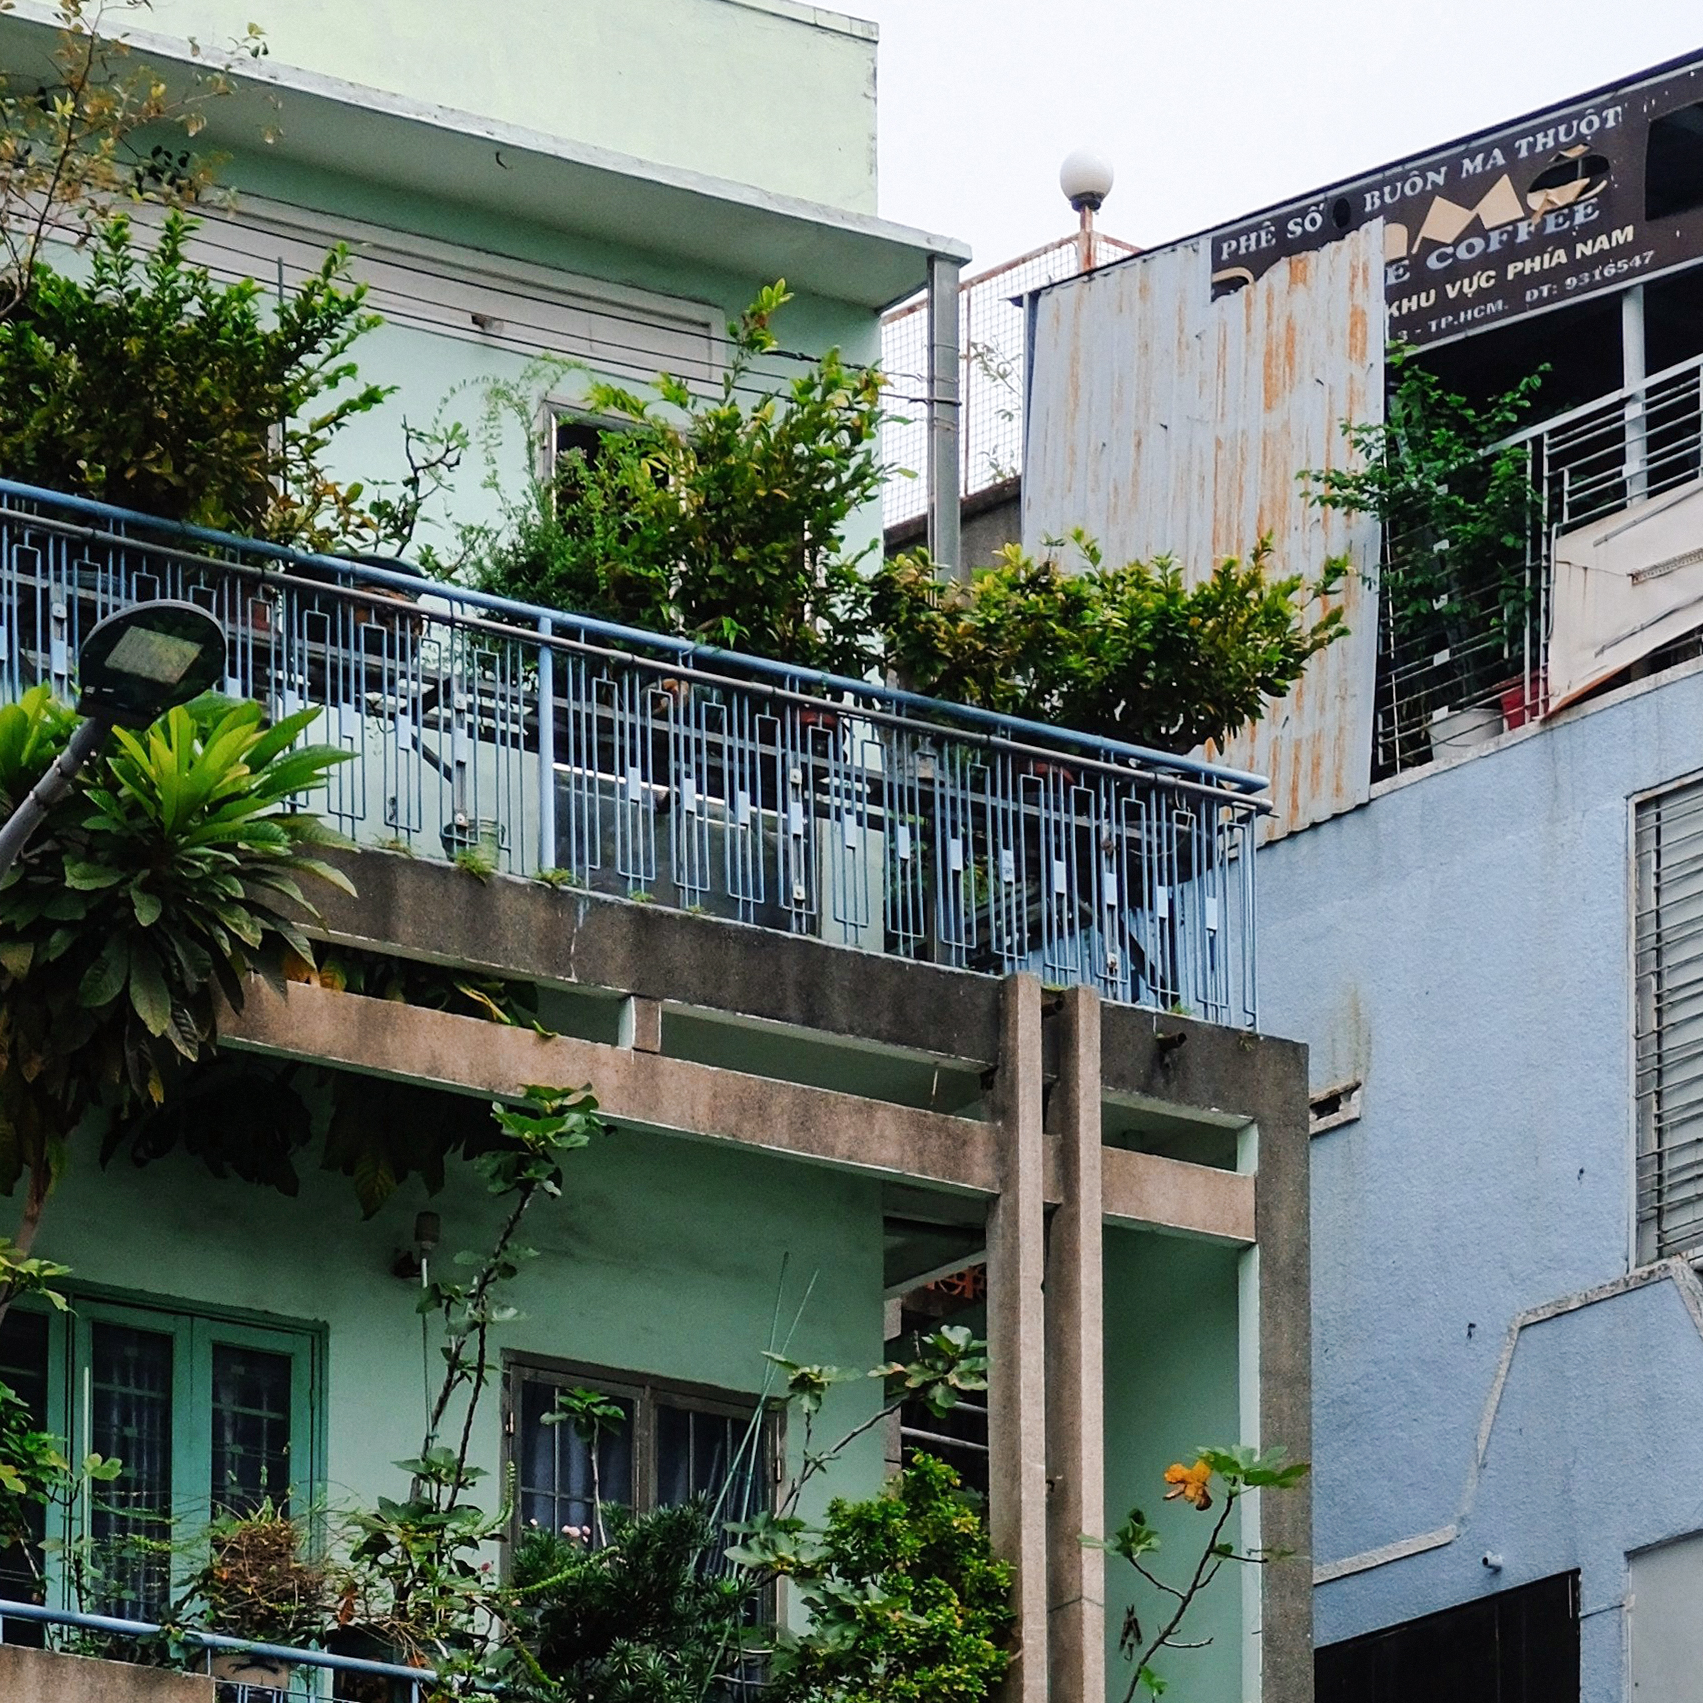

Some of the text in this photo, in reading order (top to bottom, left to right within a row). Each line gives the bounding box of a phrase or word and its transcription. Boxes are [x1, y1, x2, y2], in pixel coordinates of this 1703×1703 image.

[1220, 226, 1277, 262] PHÊ
[1363, 166, 1448, 213] BUÔN
[1460, 148, 1508, 180] MA
[1513, 105, 1624, 160] THUỘT
[1386, 224, 1635, 320] KHU VỰC PHÍA NAM
[1426, 197, 1601, 272] COFFEE
